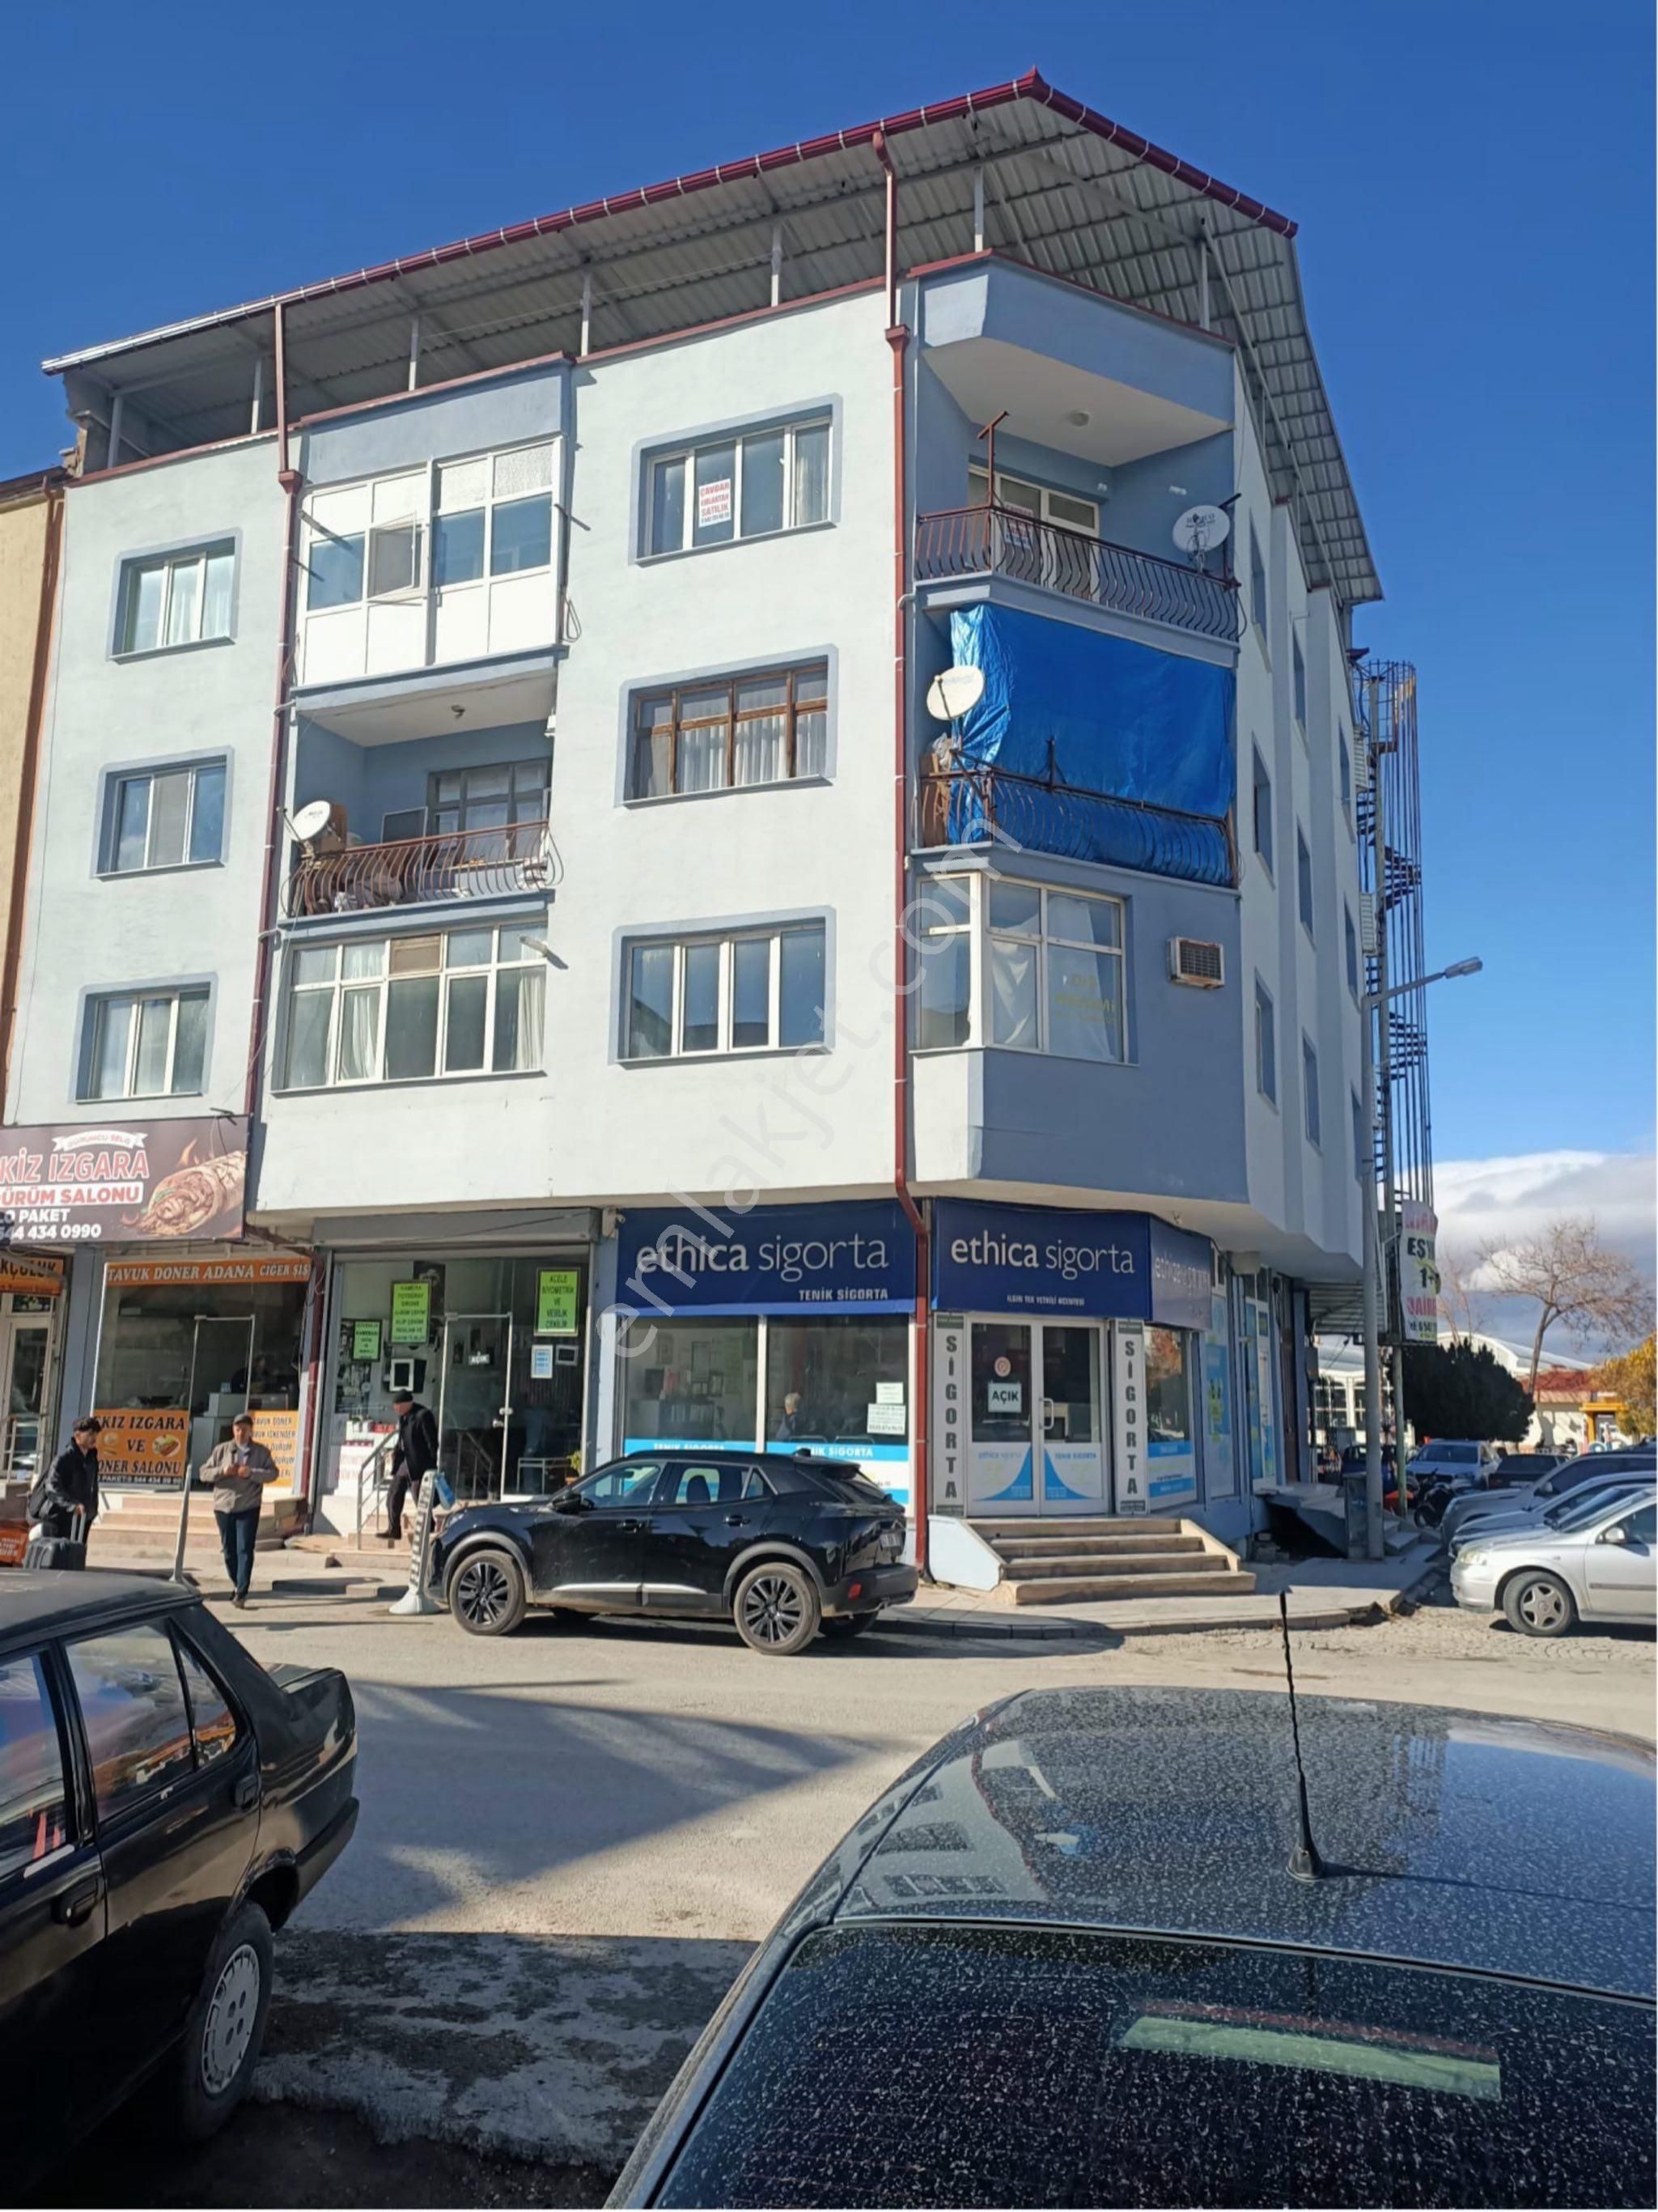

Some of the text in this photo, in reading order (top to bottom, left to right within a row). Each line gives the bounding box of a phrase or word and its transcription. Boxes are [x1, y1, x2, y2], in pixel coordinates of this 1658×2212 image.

[49, 1150, 150, 1182] IZGARA
[0, 1186, 139, 1205] ÜRÜM SALONU
[19, 1208, 70, 1223] PAKET
[28, 1225, 57, 1240] 434
[61, 1224, 101, 1238] 0990
[636, 1232, 889, 1282] ethica sigorta
[952, 1230, 1134, 1280] ethica sigorta
[108, 1267, 150, 1281] TAVUK
[203, 1264, 255, 1279] ADANA
[799, 1286, 888, 1301] TENİK SİGORTA
[991, 1390, 1019, 1406] AÇIK
[129, 1416, 184, 1430] IZGARA
[127, 1439, 146, 1453] VE
[132, 1460, 181, 1474] SALONU
